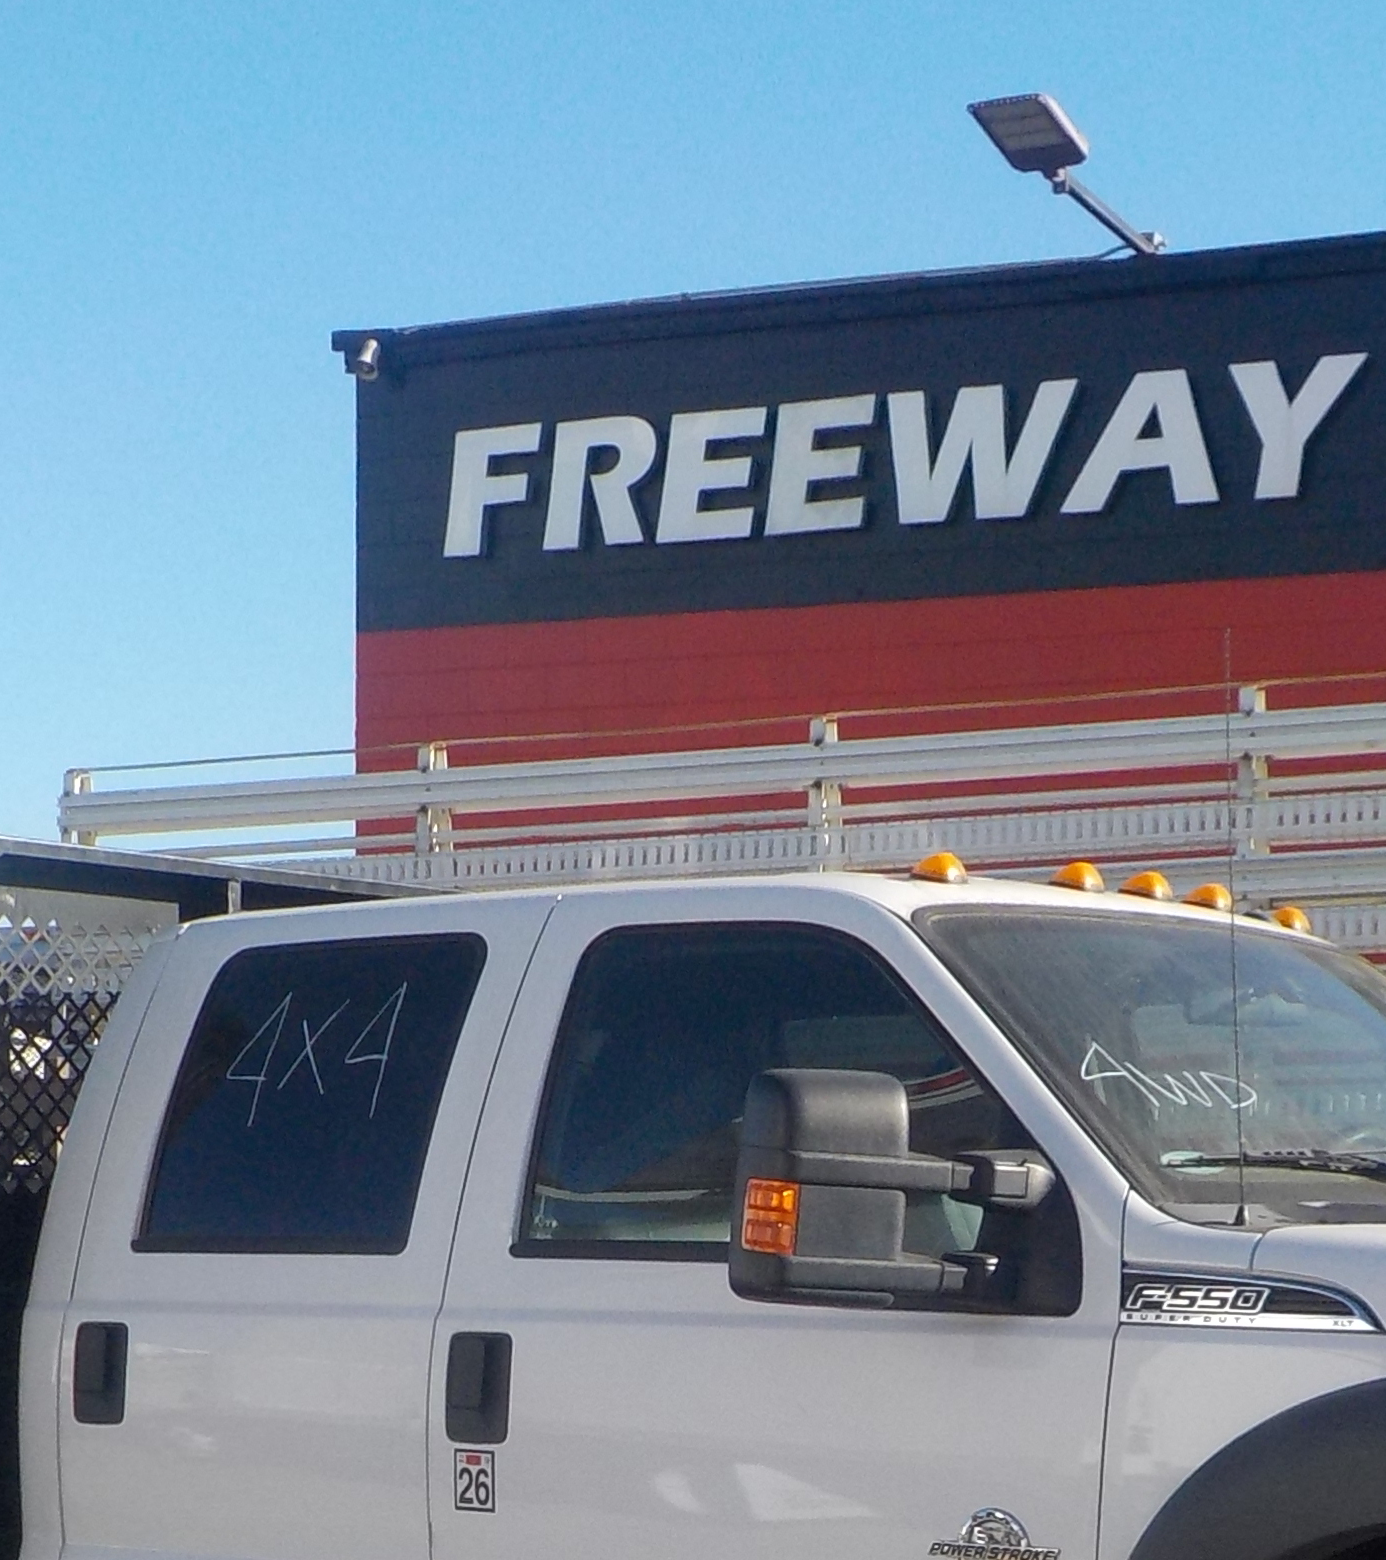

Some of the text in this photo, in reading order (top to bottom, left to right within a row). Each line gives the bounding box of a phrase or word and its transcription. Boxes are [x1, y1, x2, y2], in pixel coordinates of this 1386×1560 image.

[442, 352, 1369, 559] FREEWAY
[1124, 1283, 1271, 1315] F-550
[1125, 1313, 1258, 1325] SUPER DUTY
[1332, 1320, 1355, 1328] XLT
[458, 1467, 490, 1507] 26
[928, 1541, 986, 1559] POWER
